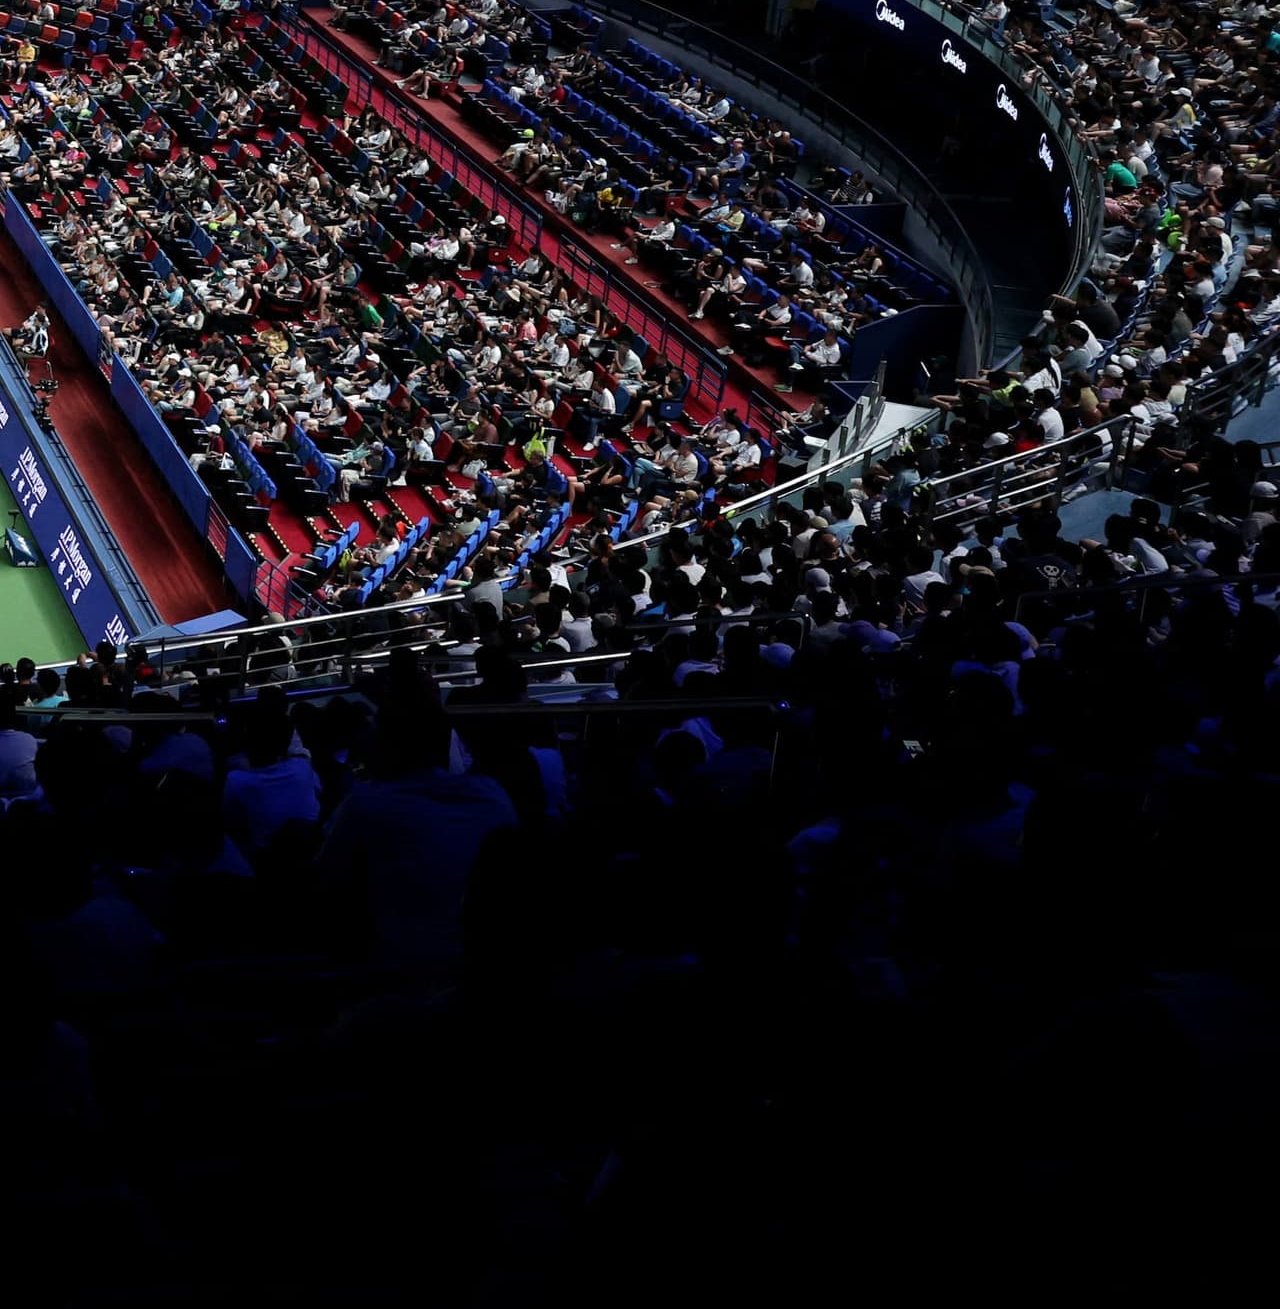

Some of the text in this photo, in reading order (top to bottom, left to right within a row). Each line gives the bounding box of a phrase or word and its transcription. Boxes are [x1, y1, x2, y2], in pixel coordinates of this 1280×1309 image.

[941, 39, 966, 73] Midea
[19, 446, 48, 498] J.P.Morgan
[60, 524, 92, 586] J.P.Morgan
